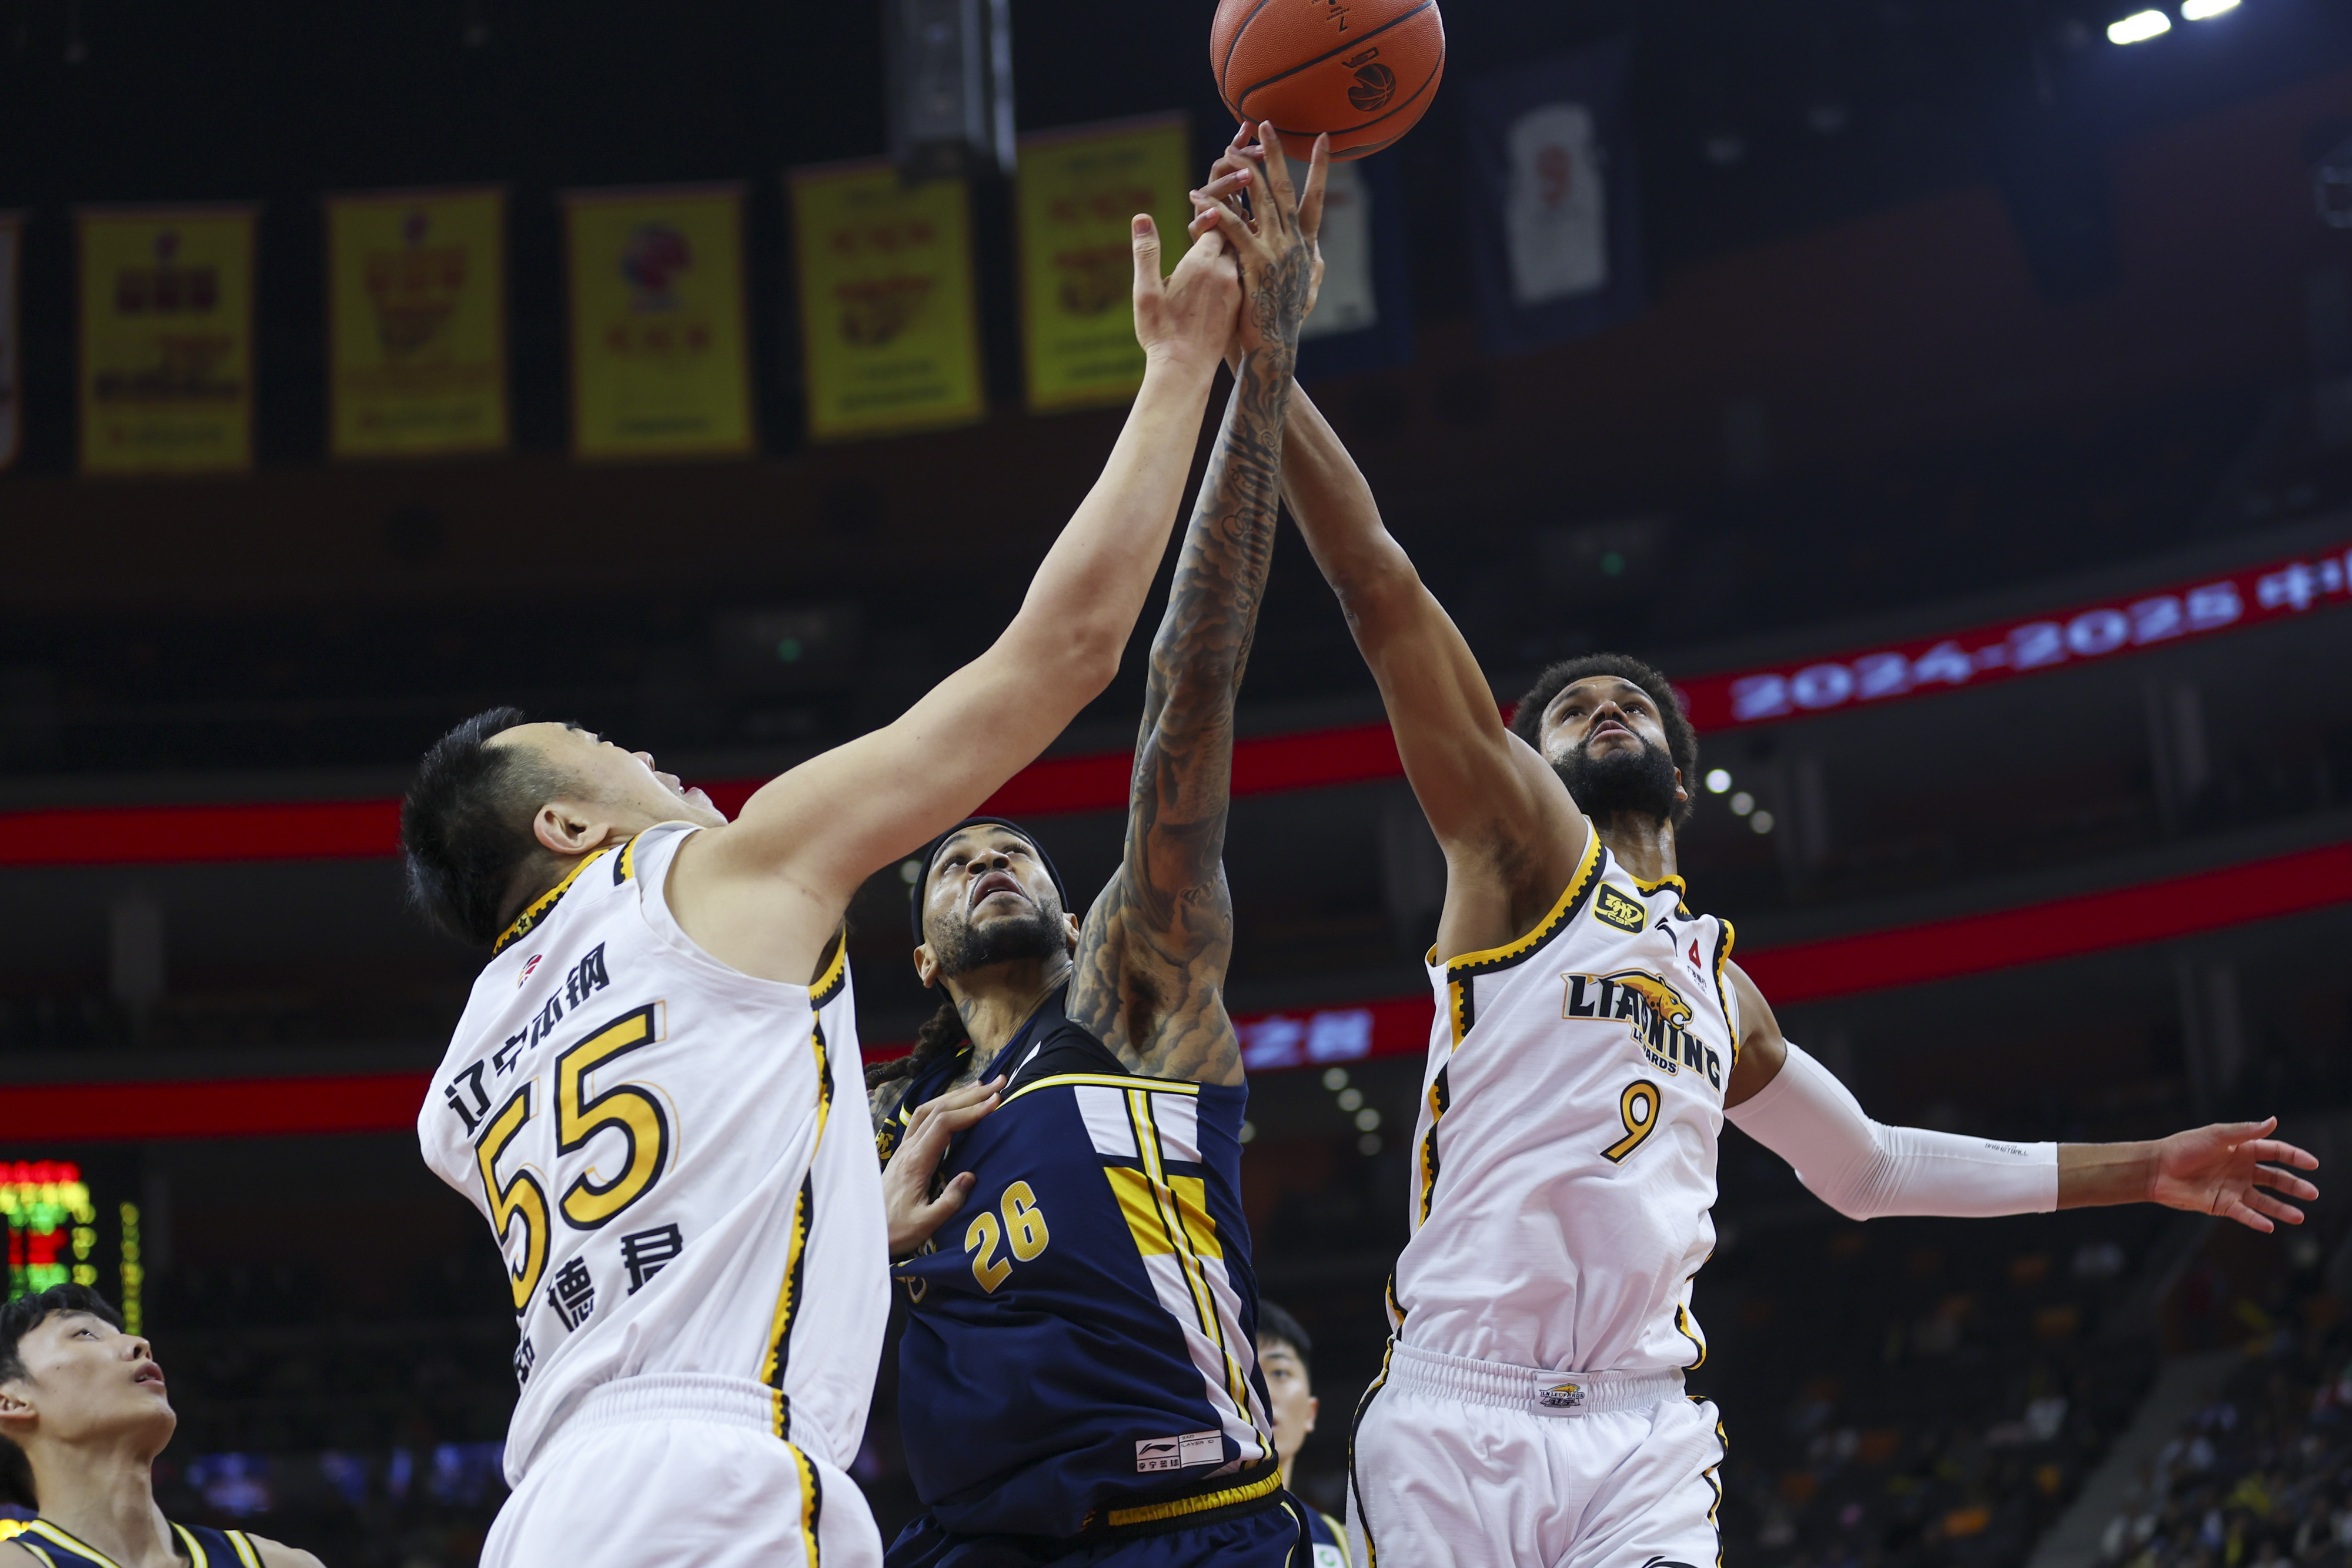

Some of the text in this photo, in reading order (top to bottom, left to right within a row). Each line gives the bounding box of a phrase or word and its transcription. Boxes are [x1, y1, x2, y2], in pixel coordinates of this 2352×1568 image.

[1730, 579, 2244, 722] 2024-2025
[444, 941, 610, 1139] 辽宁本钢
[474, 1000, 675, 1317] 55
[1600, 1079, 1663, 1164] 9
[964, 1181, 1049, 1293] 26
[1138, 1459, 1180, 1470] 李宁篮球
